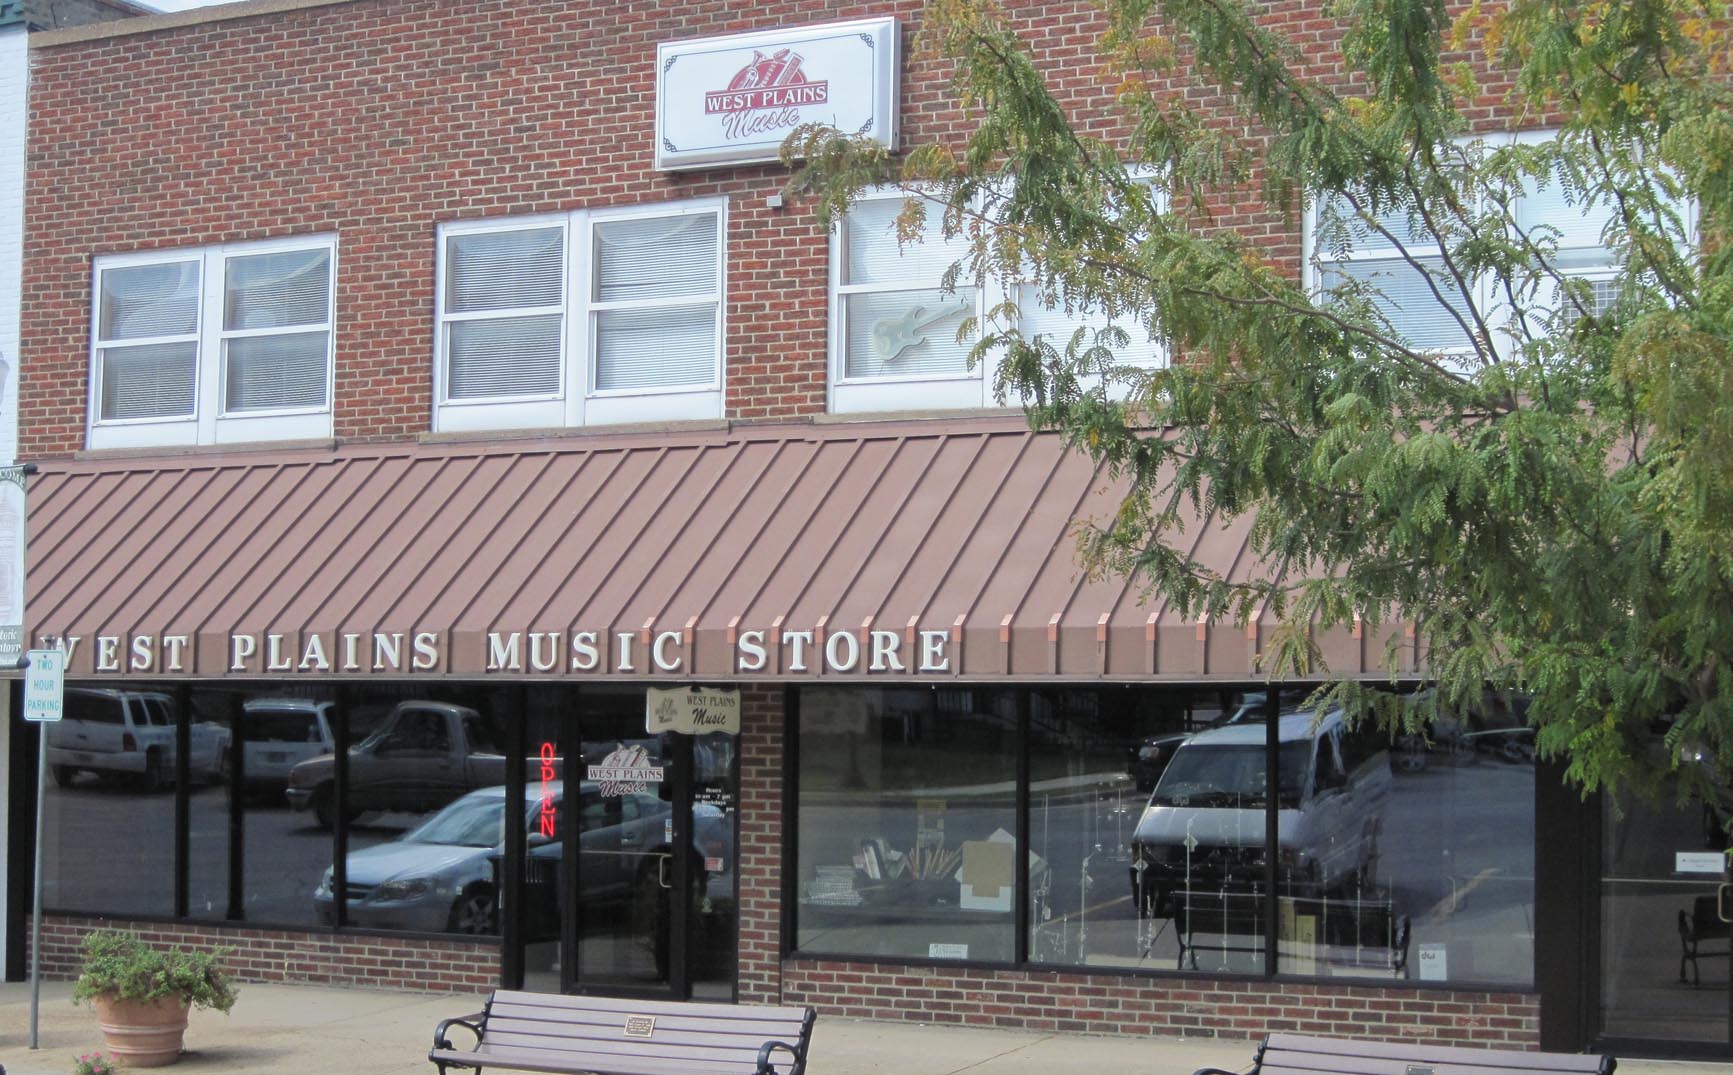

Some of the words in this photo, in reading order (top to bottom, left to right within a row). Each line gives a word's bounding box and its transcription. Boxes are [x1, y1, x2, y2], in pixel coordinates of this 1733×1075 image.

[707, 92, 755, 112] WEST
[762, 85, 827, 106] PLAINS
[721, 105, 800, 140] Music
[231, 633, 441, 671] PLAINS
[487, 631, 684, 672] MUSIC
[738, 629, 950, 672] STORE
[37, 659, 53, 671] TWO
[33, 679, 55, 691] HOUR
[27, 699, 60, 712] PARKING
[686, 695, 707, 706] WEST
[709, 696, 736, 708] PLAINS
[691, 708, 726, 726] Music
[589, 769, 618, 778] WEST
[623, 769, 663, 780] PLAINS
[540, 741, 556, 838] OPEN
[598, 780, 647, 798] Music
